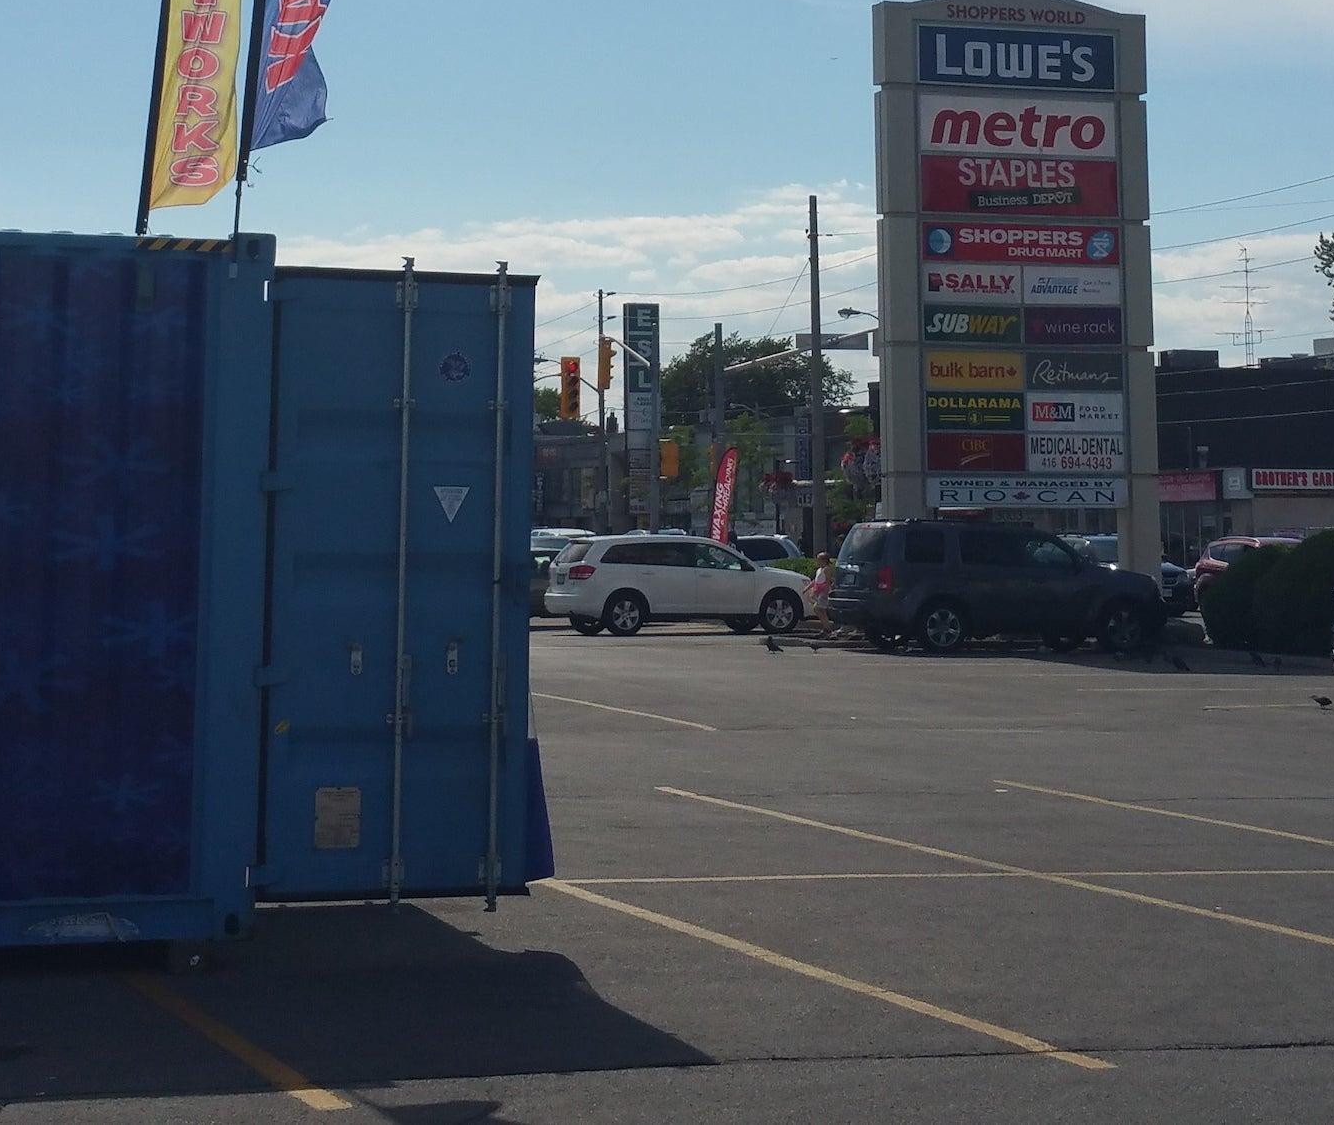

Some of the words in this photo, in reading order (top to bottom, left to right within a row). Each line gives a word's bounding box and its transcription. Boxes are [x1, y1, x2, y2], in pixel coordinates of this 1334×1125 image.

[947, 4, 1025, 22] SHOPPERS
[1030, 9, 1085, 24] WORLD
[936, 33, 1095, 82] LOWE'S
[931, 106, 1105, 149] metro
[958, 158, 1076, 188] STAPLES
[978, 194, 1028, 206] Business
[1033, 191, 1072, 205] DEPOT
[958, 228, 1084, 246] SHOPPERS
[1008, 247, 1045, 257] DRUG
[1046, 248, 1083, 258] MART
[945, 273, 1015, 290] SALLY
[1030, 284, 1079, 295] ADVANTAGE
[926, 313, 1017, 334] SUBWAY
[1046, 322, 1081, 334] wine
[1083, 320, 1116, 334] rack
[930, 361, 964, 378] bulk
[969, 362, 1005, 378] barn
[1033, 359, 1117, 384] Reitmans
[928, 397, 1021, 409] DOLLARAMA
[1035, 404, 1073, 419] M&M
[961, 438, 989, 452] CIBC
[1031, 437, 1123, 456] MEDICAL-DENTAL
[1042, 457, 1057, 468] 416
[1061, 456, 1113, 470] 694-4343
[1016, 480, 1089, 488] MANAGED
[712, 482, 724, 540] WAXING
